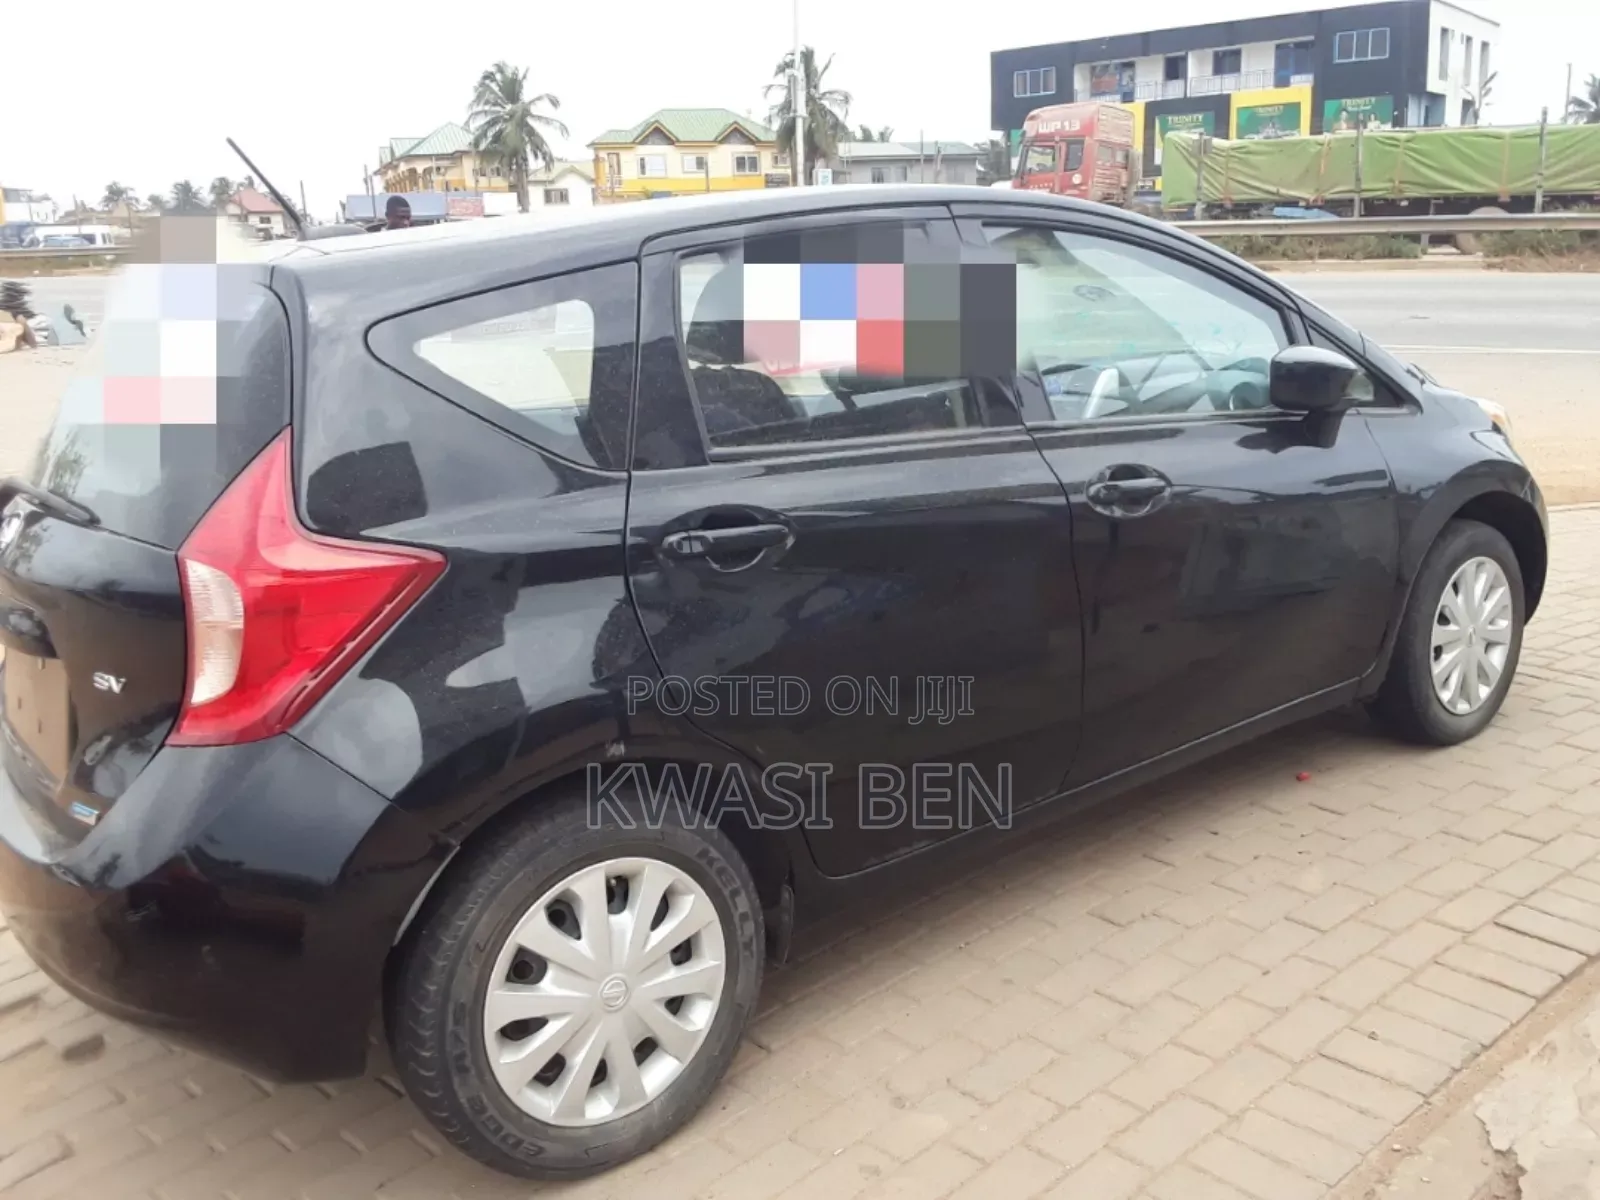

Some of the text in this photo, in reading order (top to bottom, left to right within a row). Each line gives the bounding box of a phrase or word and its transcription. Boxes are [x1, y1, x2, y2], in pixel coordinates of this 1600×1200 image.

[1165, 113, 1204, 125] TRINITY
[92, 671, 127, 694] SV
[694, 846, 754, 960] KELLY
